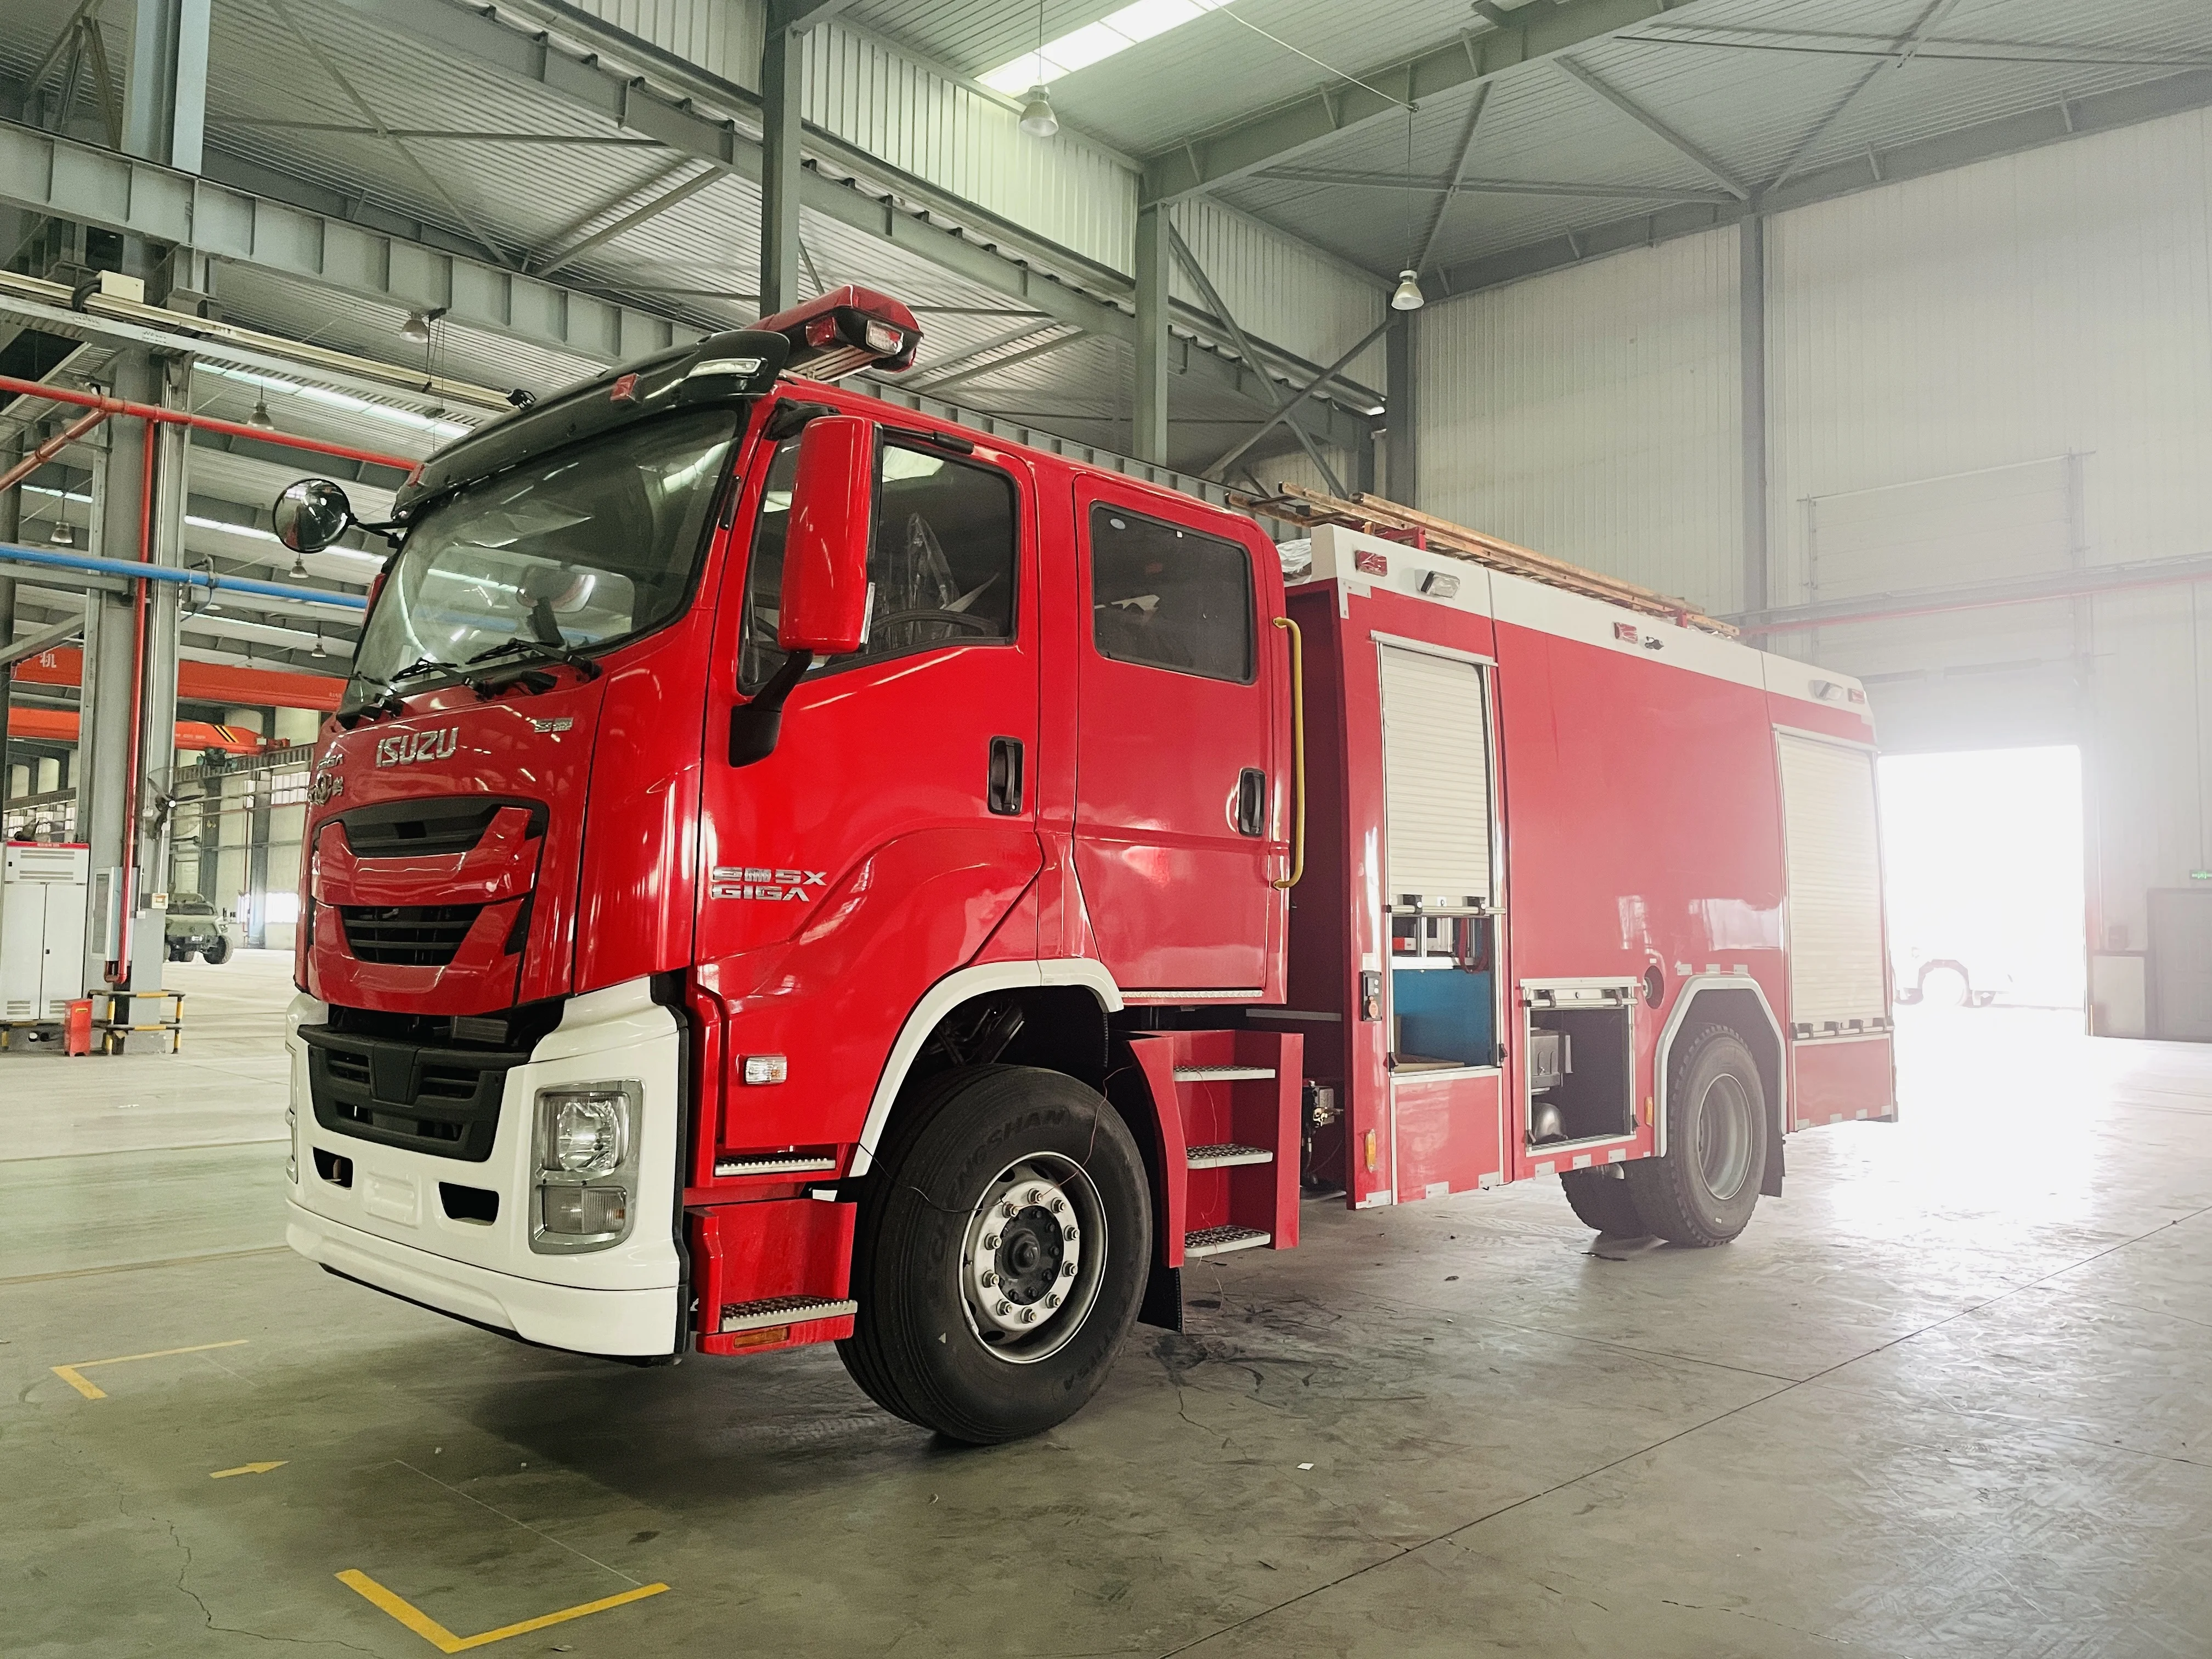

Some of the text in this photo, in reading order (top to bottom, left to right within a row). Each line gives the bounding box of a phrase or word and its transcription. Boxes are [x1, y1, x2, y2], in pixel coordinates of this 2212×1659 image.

[40, 652, 57, 668] 机
[376, 727, 459, 768] ISUZU
[712, 884, 810, 902] GIGA
